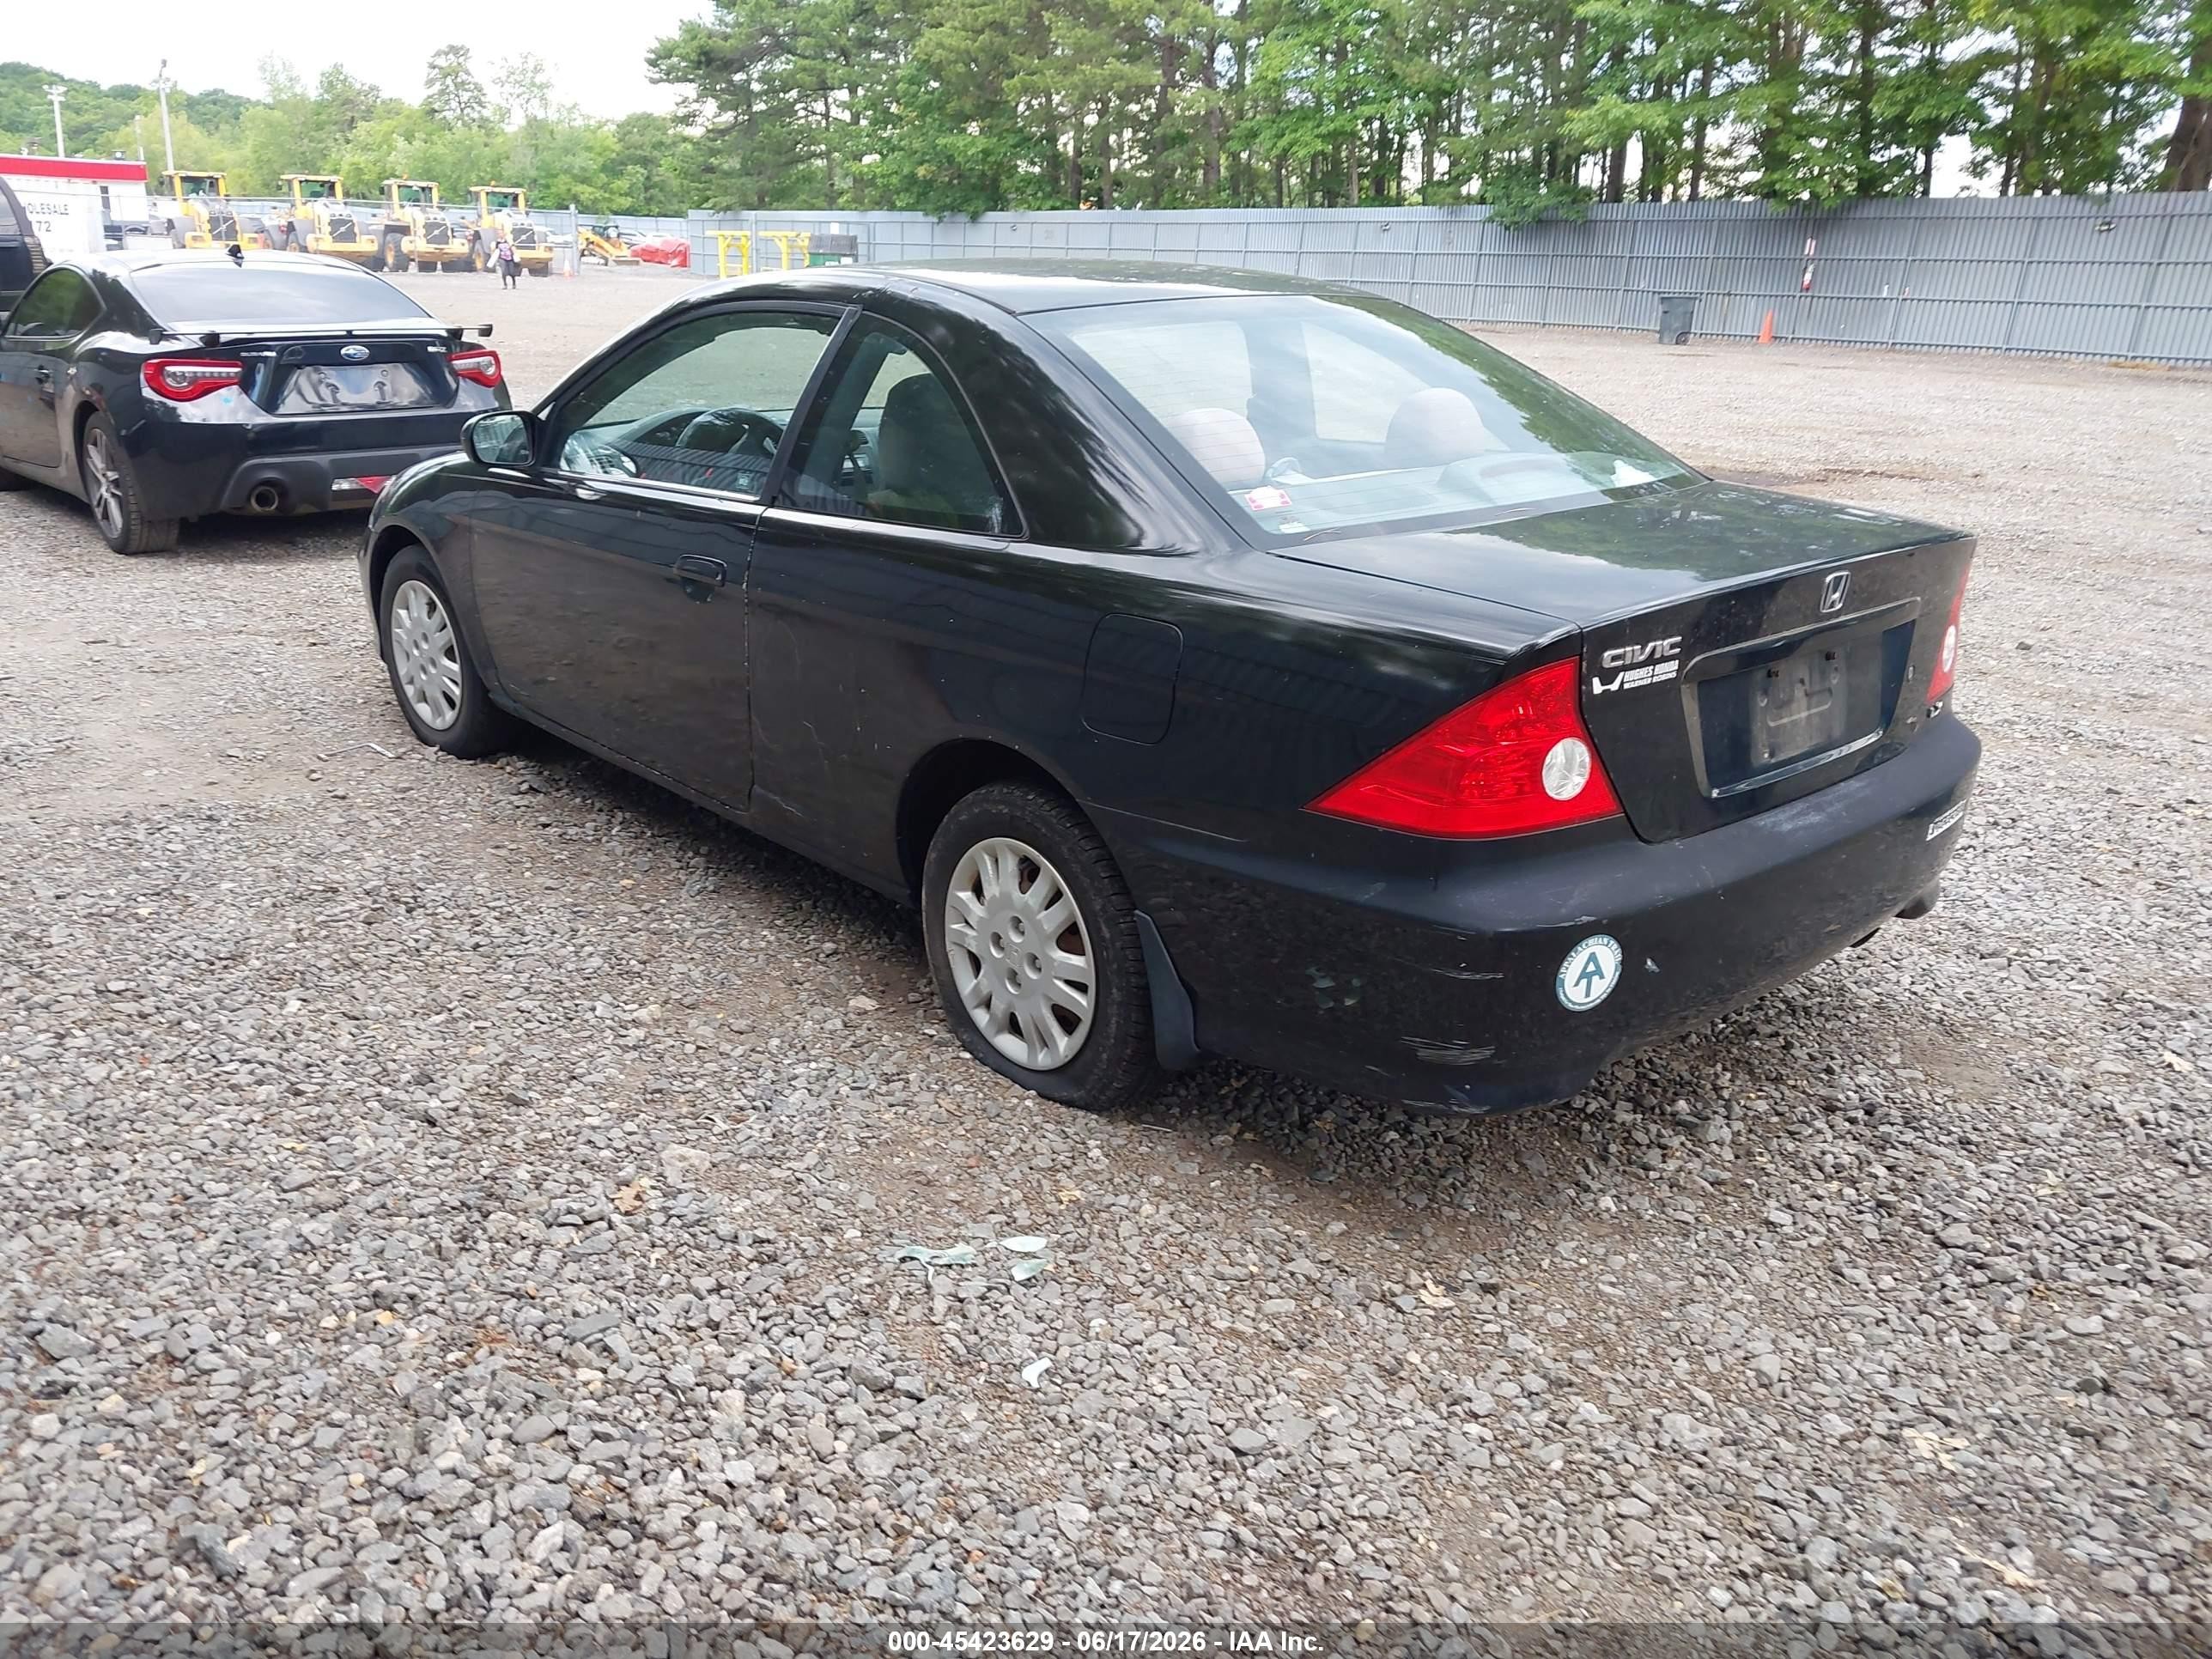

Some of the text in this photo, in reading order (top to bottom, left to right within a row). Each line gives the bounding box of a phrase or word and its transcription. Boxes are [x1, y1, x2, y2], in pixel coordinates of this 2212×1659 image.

[27, 203, 69, 216] OLESALE
[1601, 636, 1683, 668] CIVIC
[1559, 937, 1609, 979] APPALACHIAN
